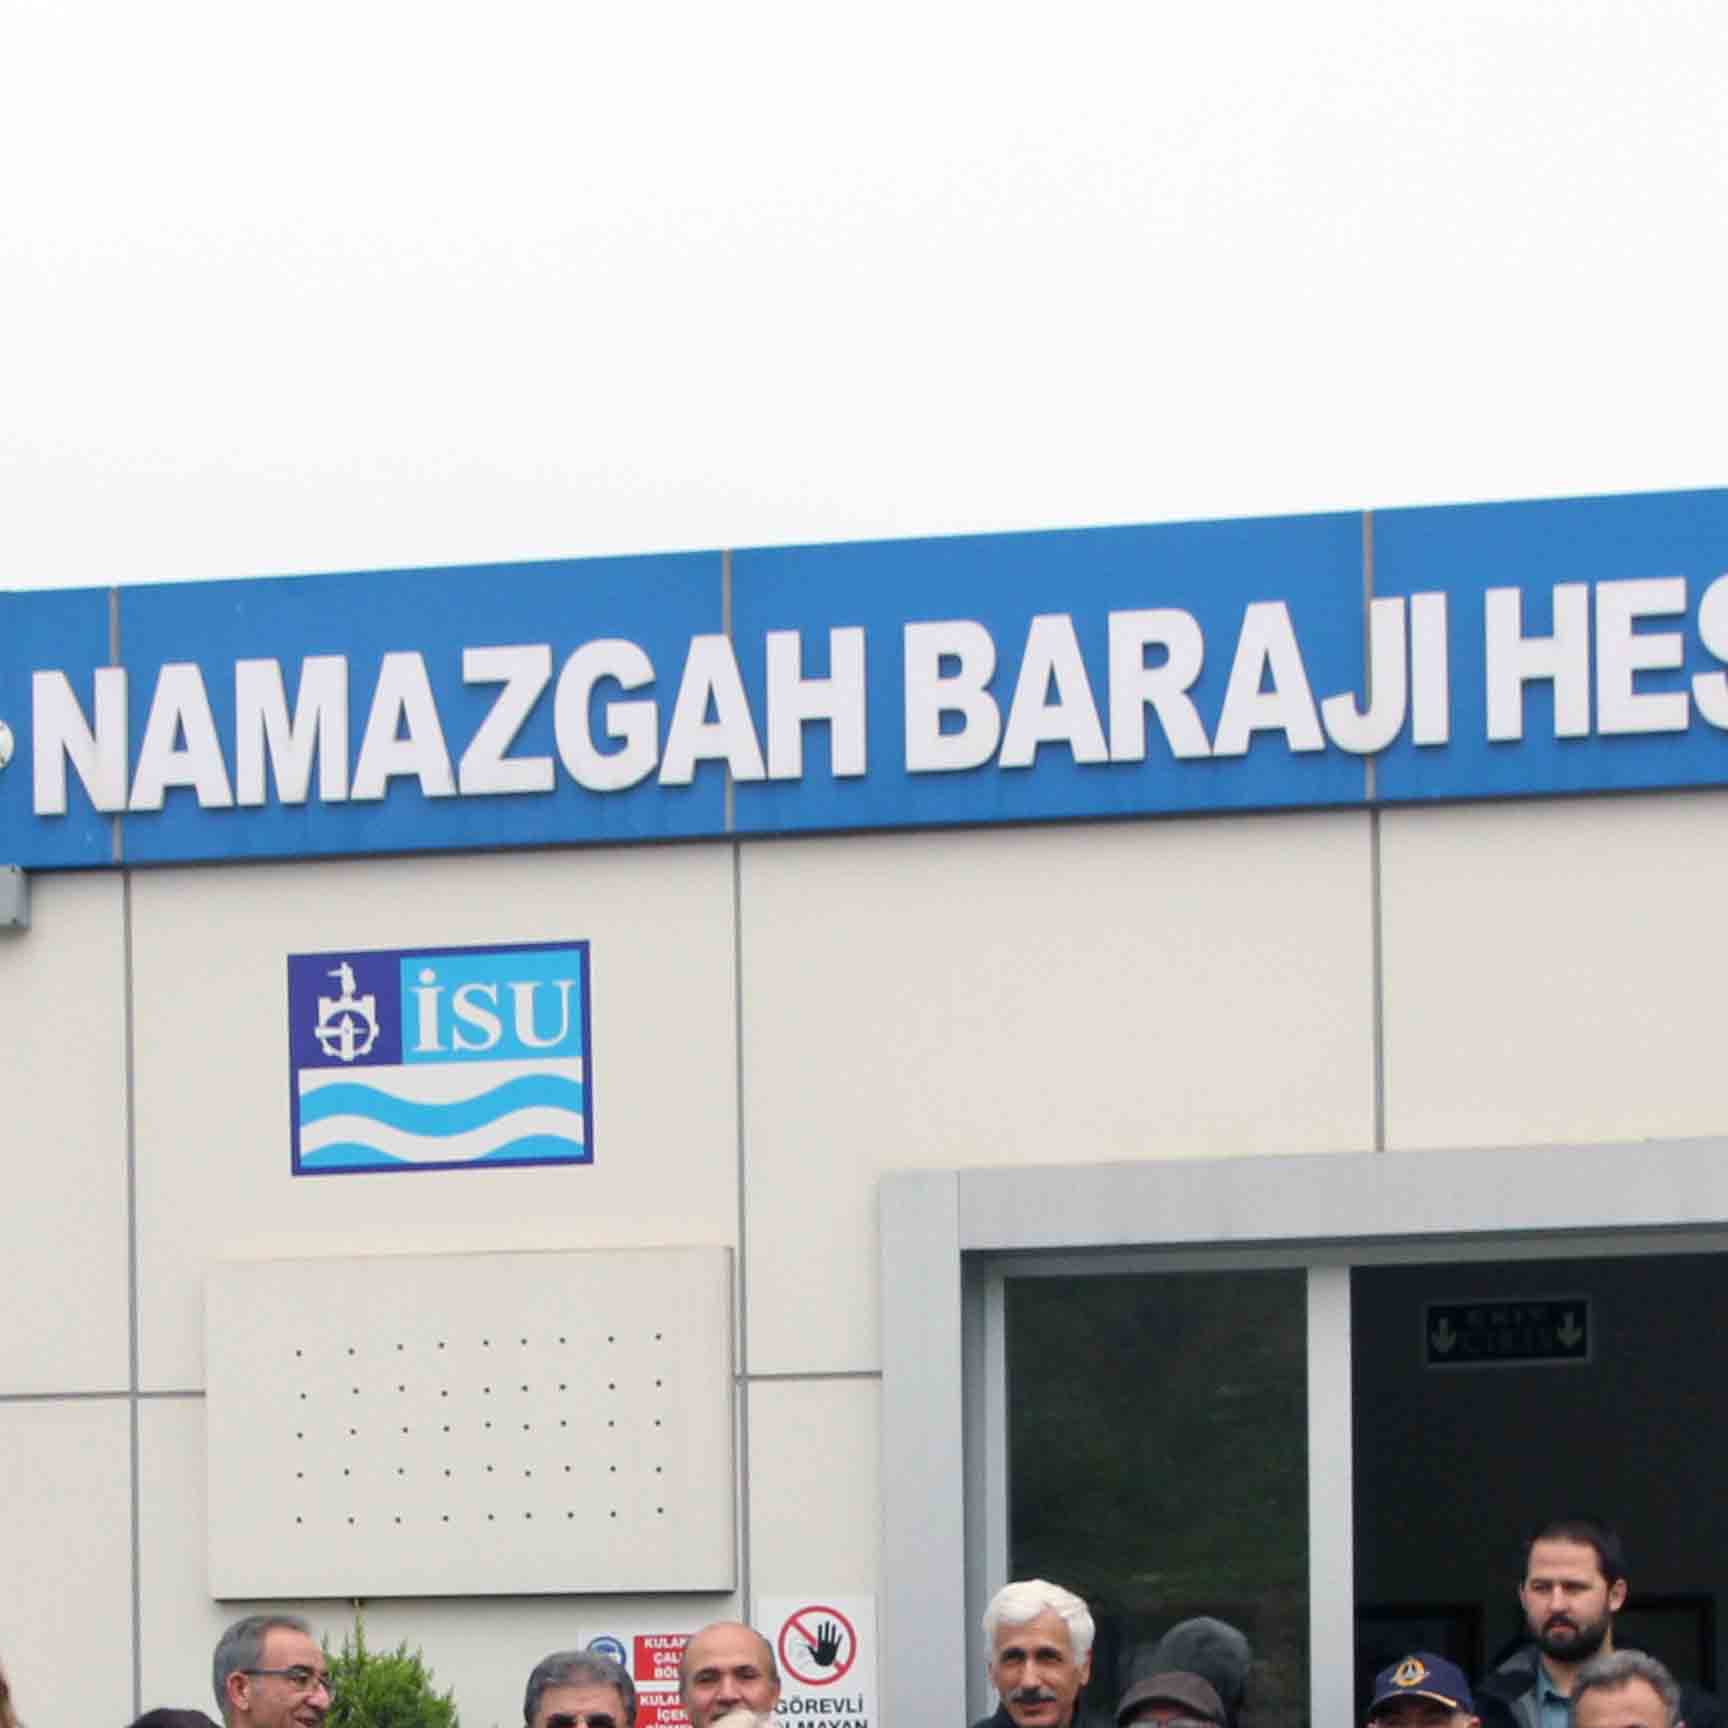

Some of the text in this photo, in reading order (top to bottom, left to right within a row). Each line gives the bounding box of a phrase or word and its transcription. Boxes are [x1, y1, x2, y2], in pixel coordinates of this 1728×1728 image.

[32, 626, 866, 816] NAMAZGAH
[904, 592, 1448, 775] BARAJI
[410, 967, 576, 1056] İSU
[774, 1692, 864, 1715] GÖREVLİ
